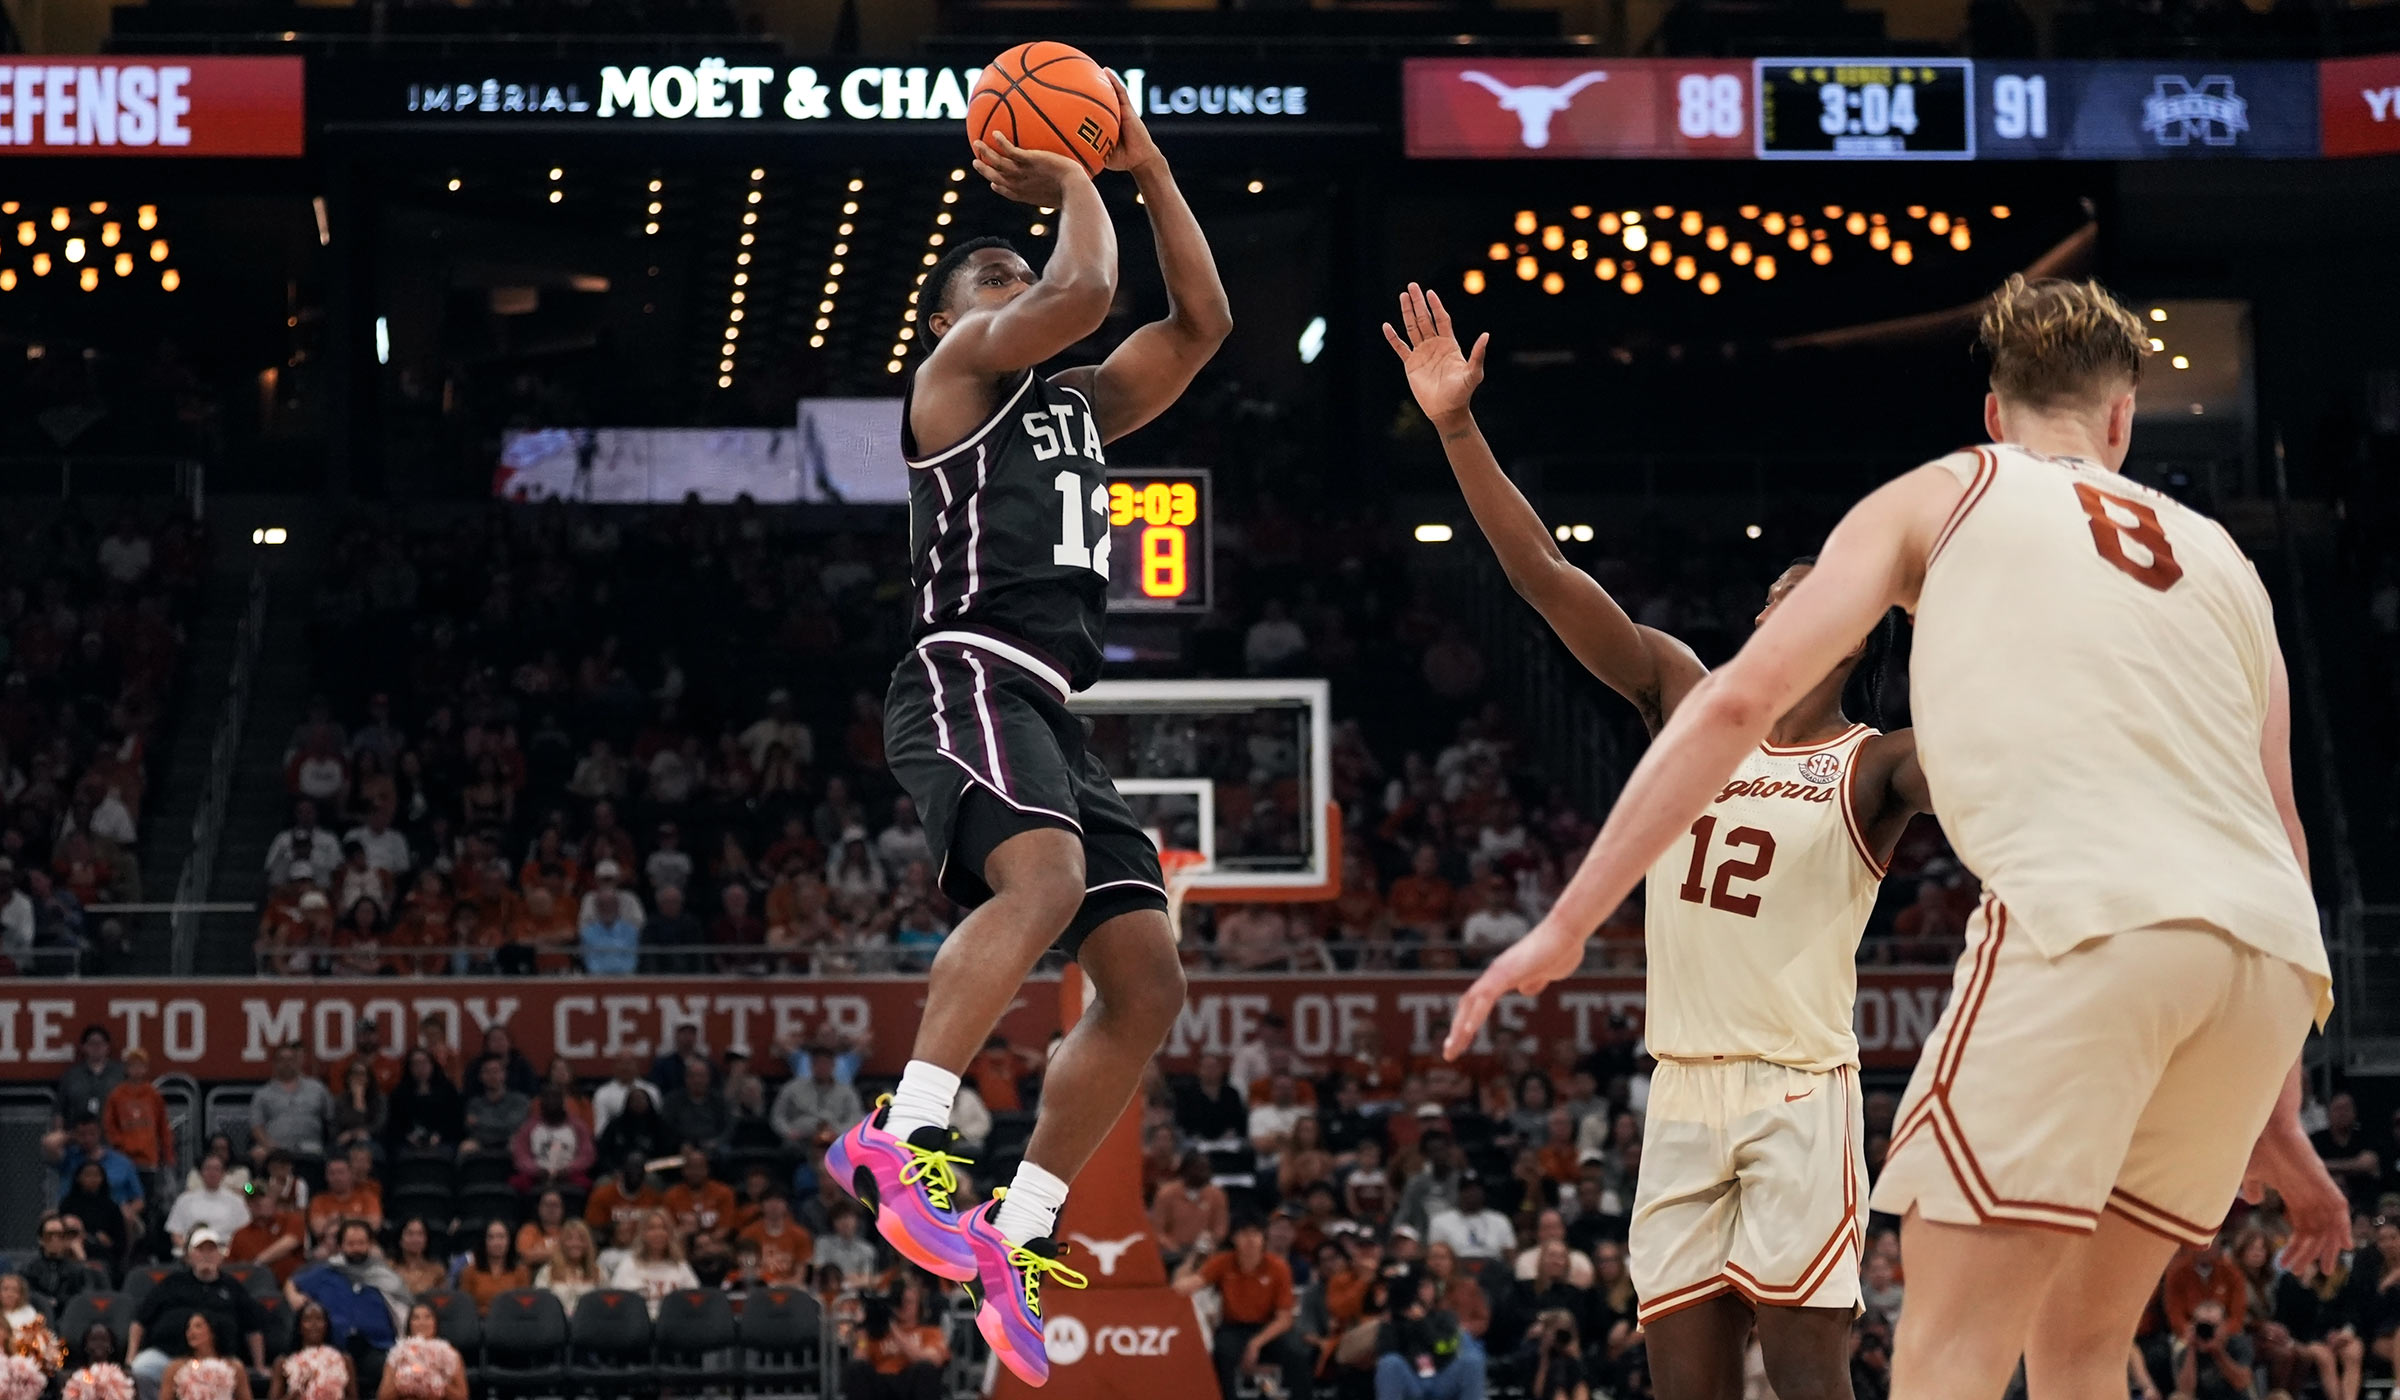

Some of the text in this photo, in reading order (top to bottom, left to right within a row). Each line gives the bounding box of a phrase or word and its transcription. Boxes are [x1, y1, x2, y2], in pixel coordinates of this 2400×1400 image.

[406, 78, 590, 112] IMPÉRIAL
[596, 57, 774, 118] MOËT
[783, 67, 831, 119] &
[1149, 86, 1307, 114] LOUNGE
[1678, 74, 1743, 138] 88
[1817, 83, 1919, 135] 3:04
[1993, 75, 2047, 138] 91
[1108, 482, 1197, 526] 3:03
[1141, 525, 1187, 598] 8
[2073, 481, 2184, 592] 8
[1807, 753, 1839, 777] SEC
[1680, 815, 1776, 918] 12
[108, 999, 206, 1062] TO
[1094, 1326, 1180, 1356] razr
